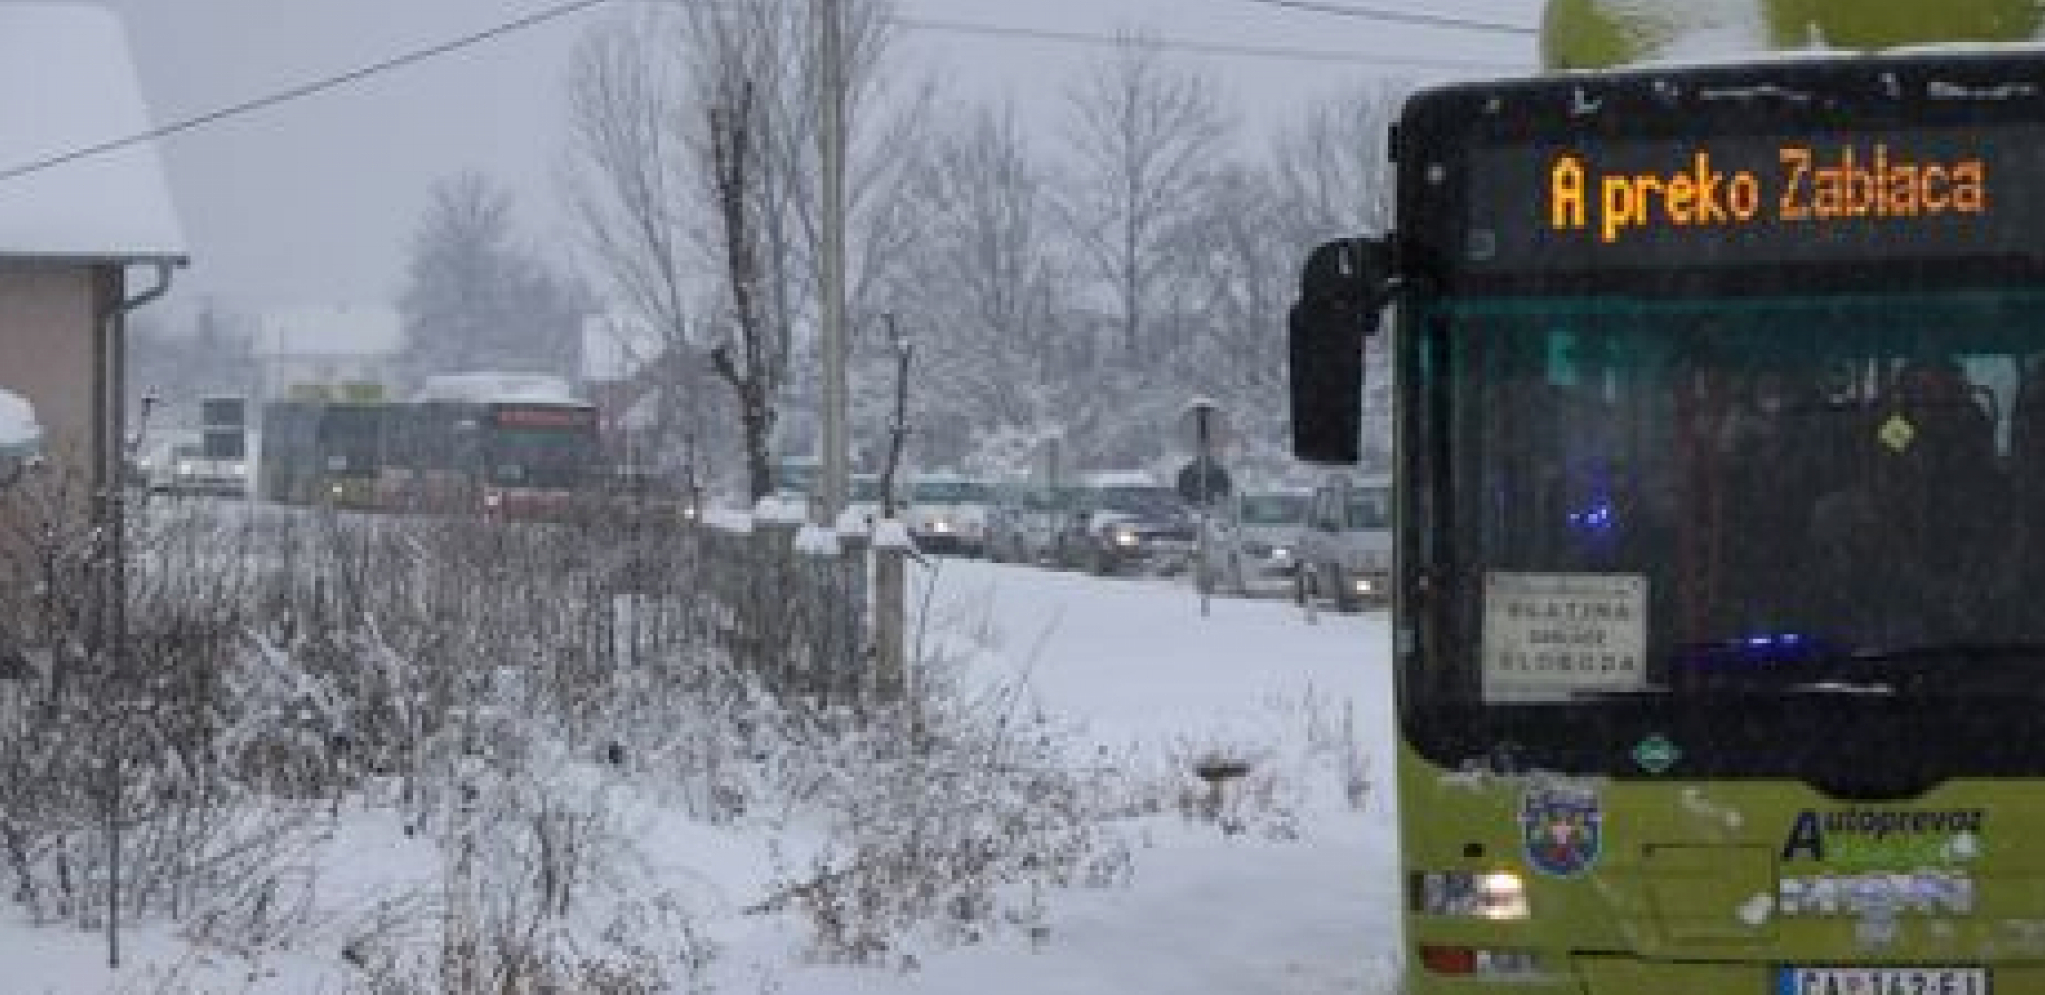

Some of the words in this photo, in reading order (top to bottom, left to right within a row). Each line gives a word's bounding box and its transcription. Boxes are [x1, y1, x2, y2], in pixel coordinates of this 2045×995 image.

[1551, 156, 1587, 230] A
[1600, 151, 1760, 244] preko
[1783, 809, 1983, 862] Autoprevoz
